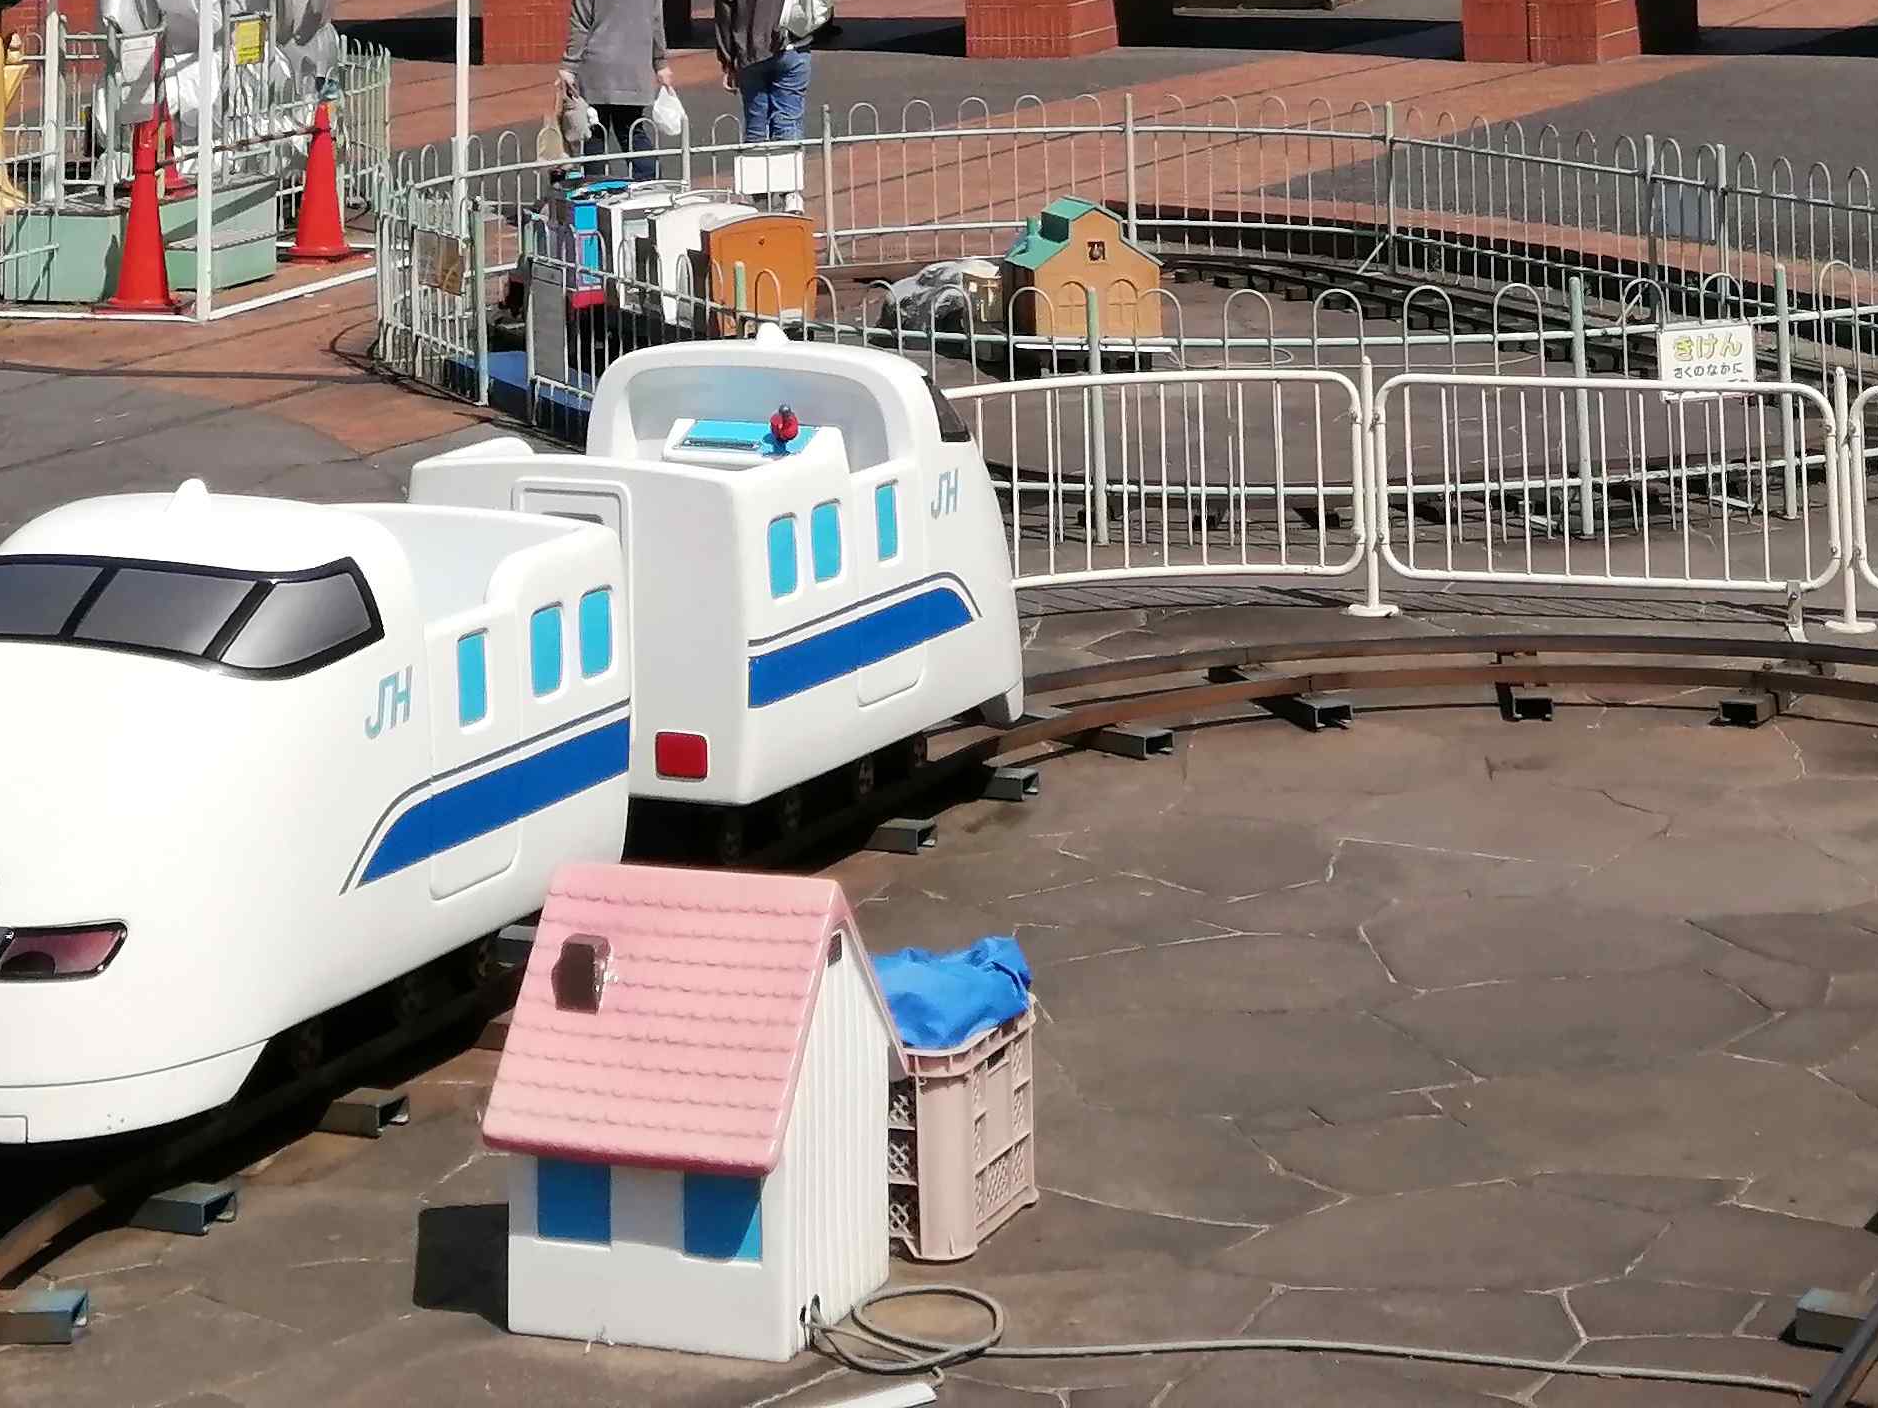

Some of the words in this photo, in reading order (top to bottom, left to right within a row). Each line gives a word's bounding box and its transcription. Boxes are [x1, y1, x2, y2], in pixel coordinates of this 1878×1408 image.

[1674, 332, 1743, 362] きけん
[1674, 362, 1744, 379] さくのなかに
